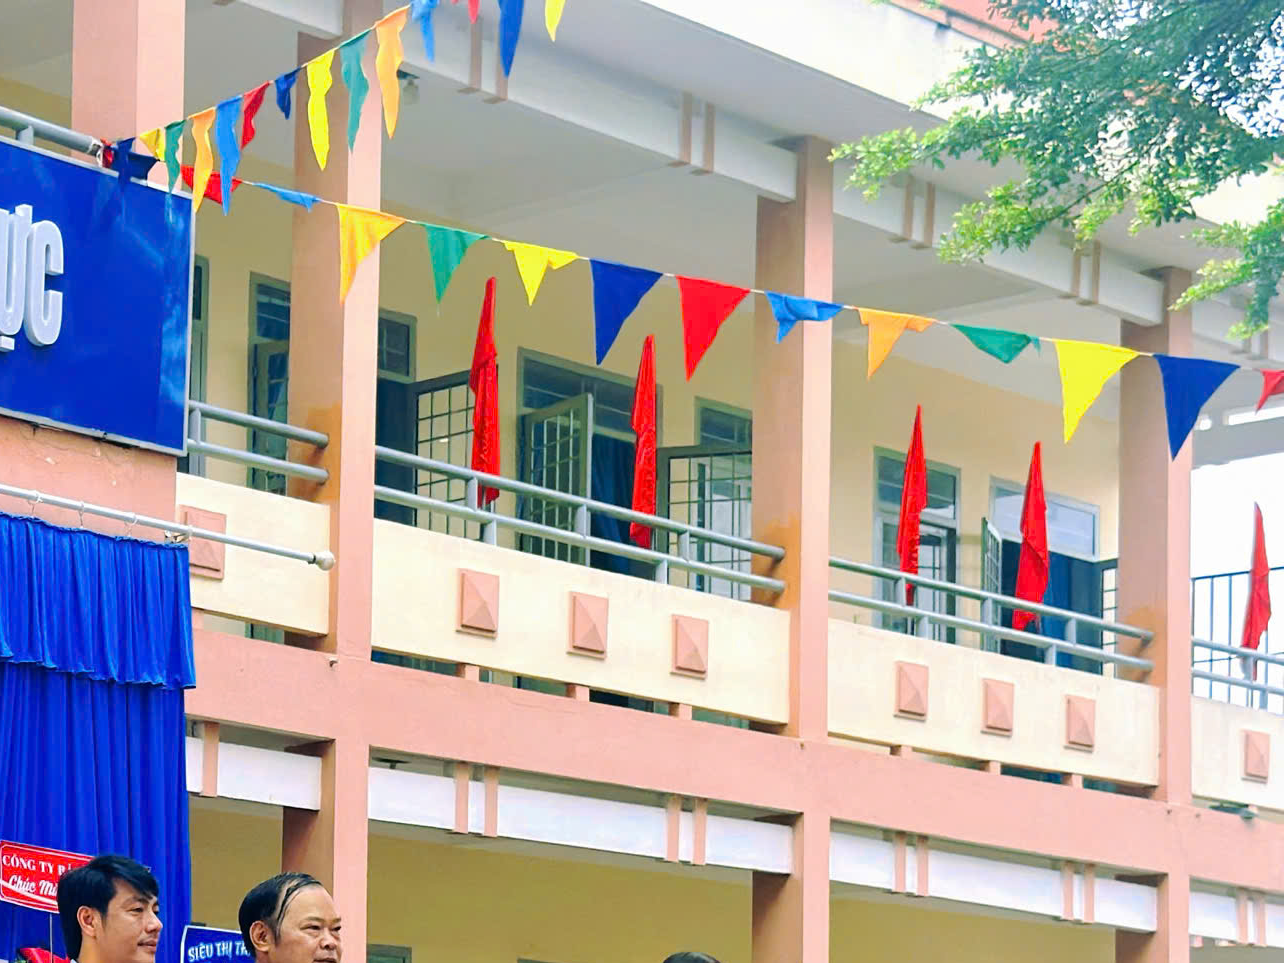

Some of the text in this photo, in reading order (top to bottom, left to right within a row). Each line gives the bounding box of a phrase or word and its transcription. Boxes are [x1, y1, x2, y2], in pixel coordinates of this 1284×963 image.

[2, 854, 36, 871] CÔNG
[39, 861, 54, 874] TY
[9, 875, 36, 892] Chúc
[188, 942, 214, 963] SIÊU
[215, 940, 233, 960] THỊ
